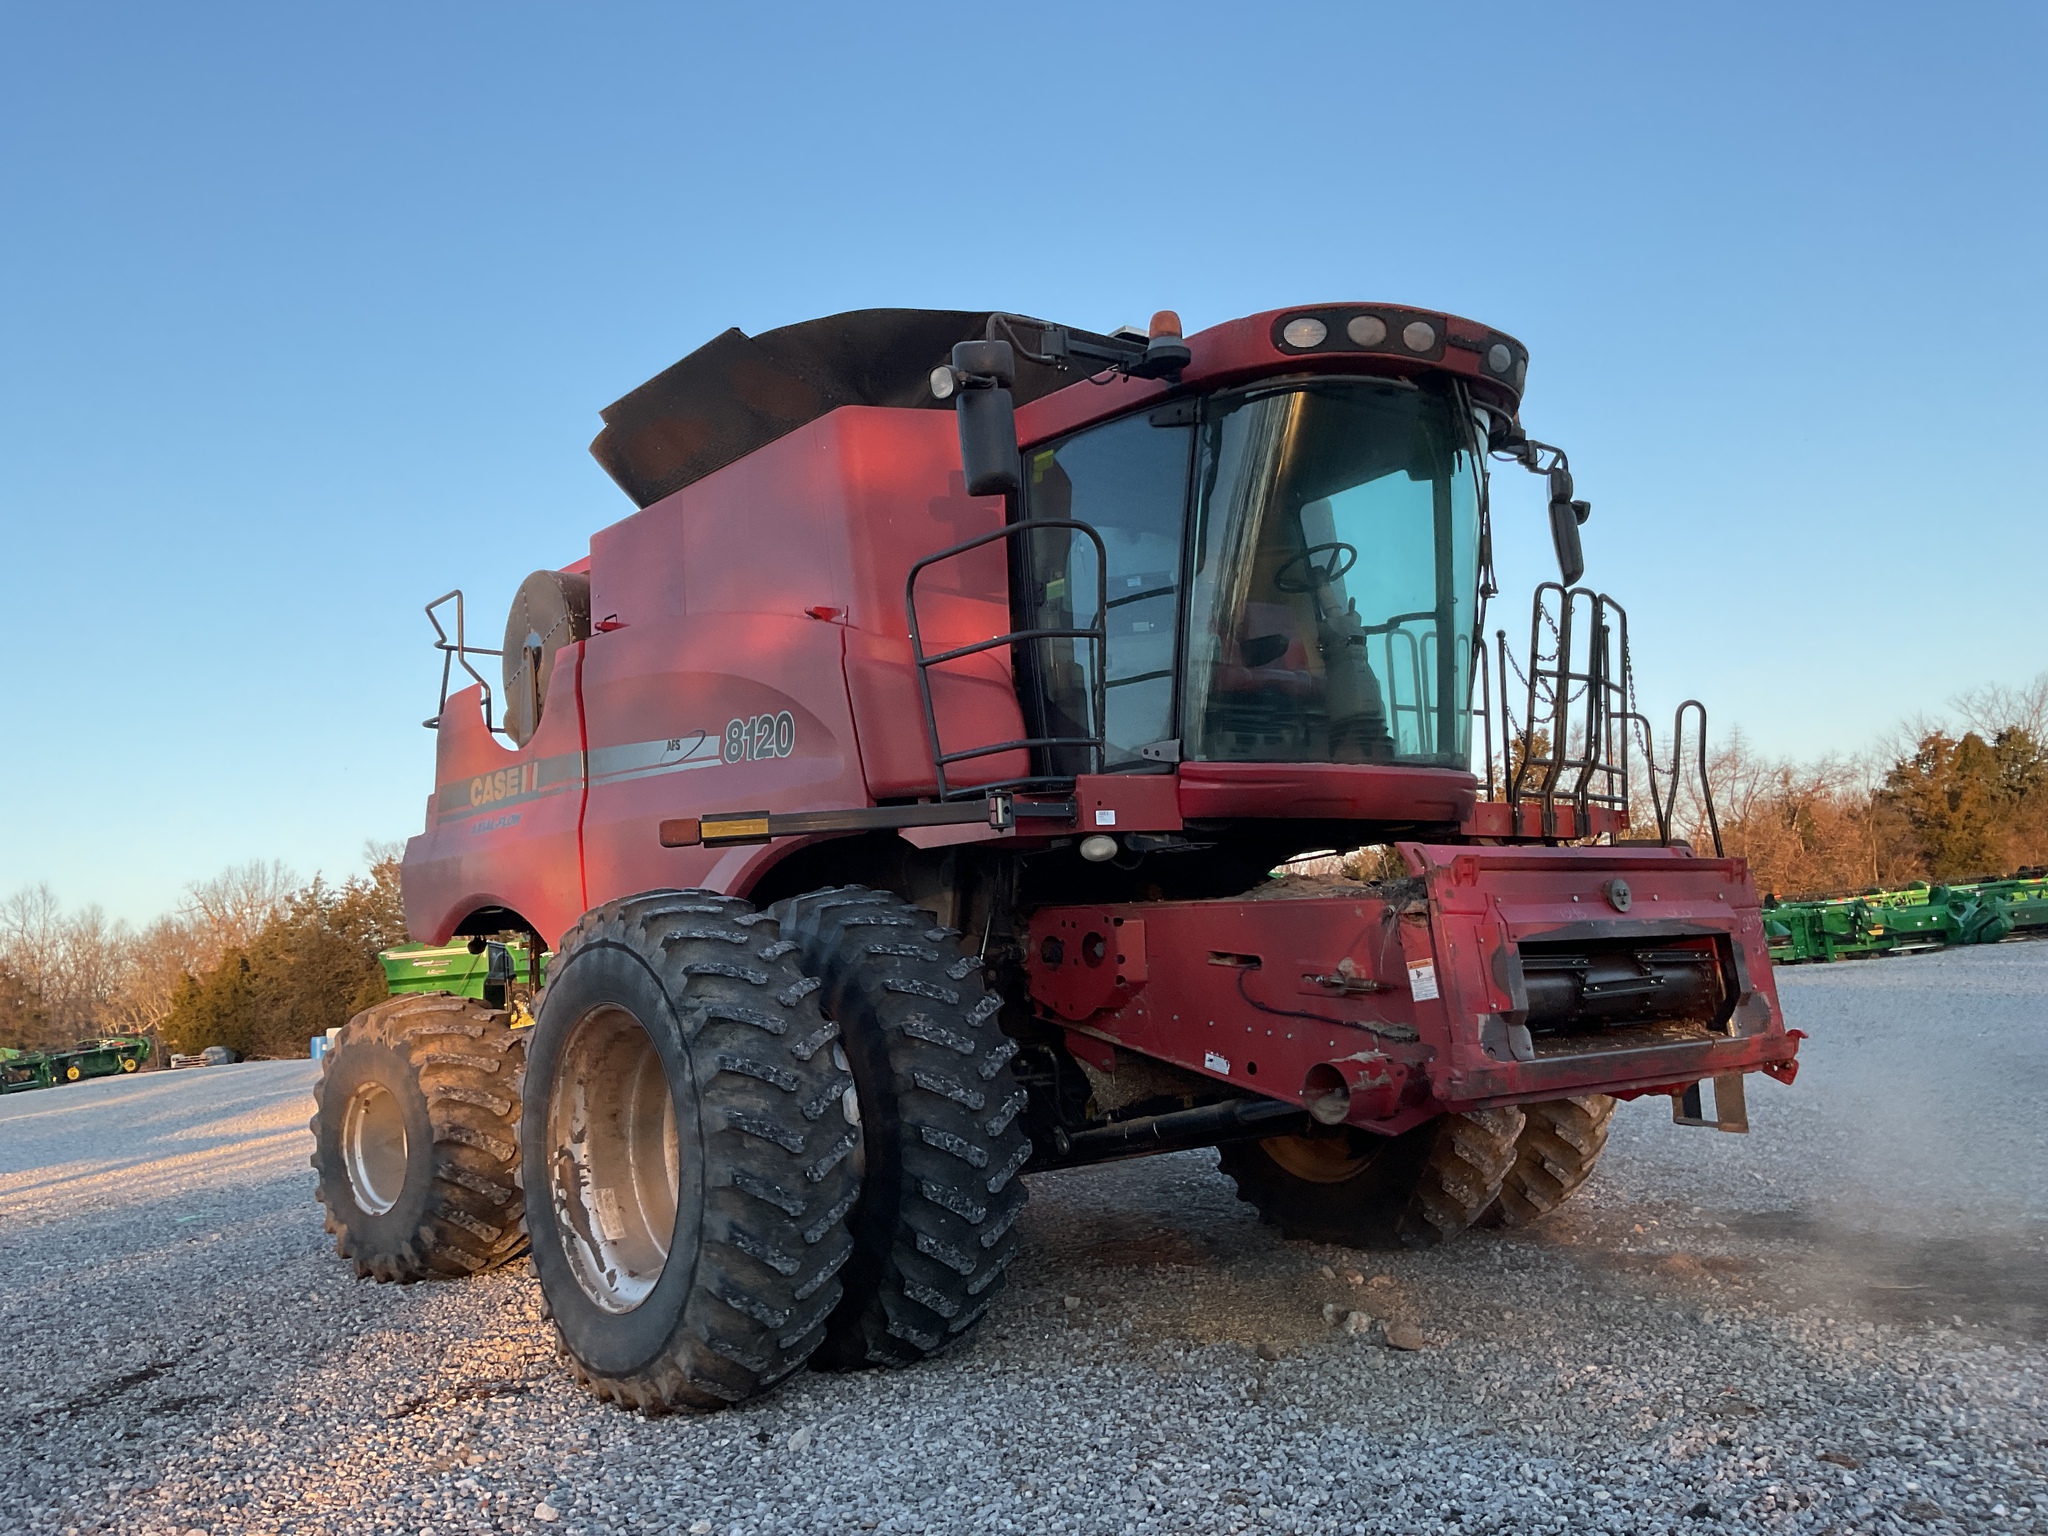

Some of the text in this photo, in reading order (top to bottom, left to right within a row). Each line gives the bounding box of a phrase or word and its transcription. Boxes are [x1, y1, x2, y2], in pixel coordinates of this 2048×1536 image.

[666, 739, 682, 752] AFS
[723, 710, 796, 765] 8120
[471, 767, 520, 808] CASE
